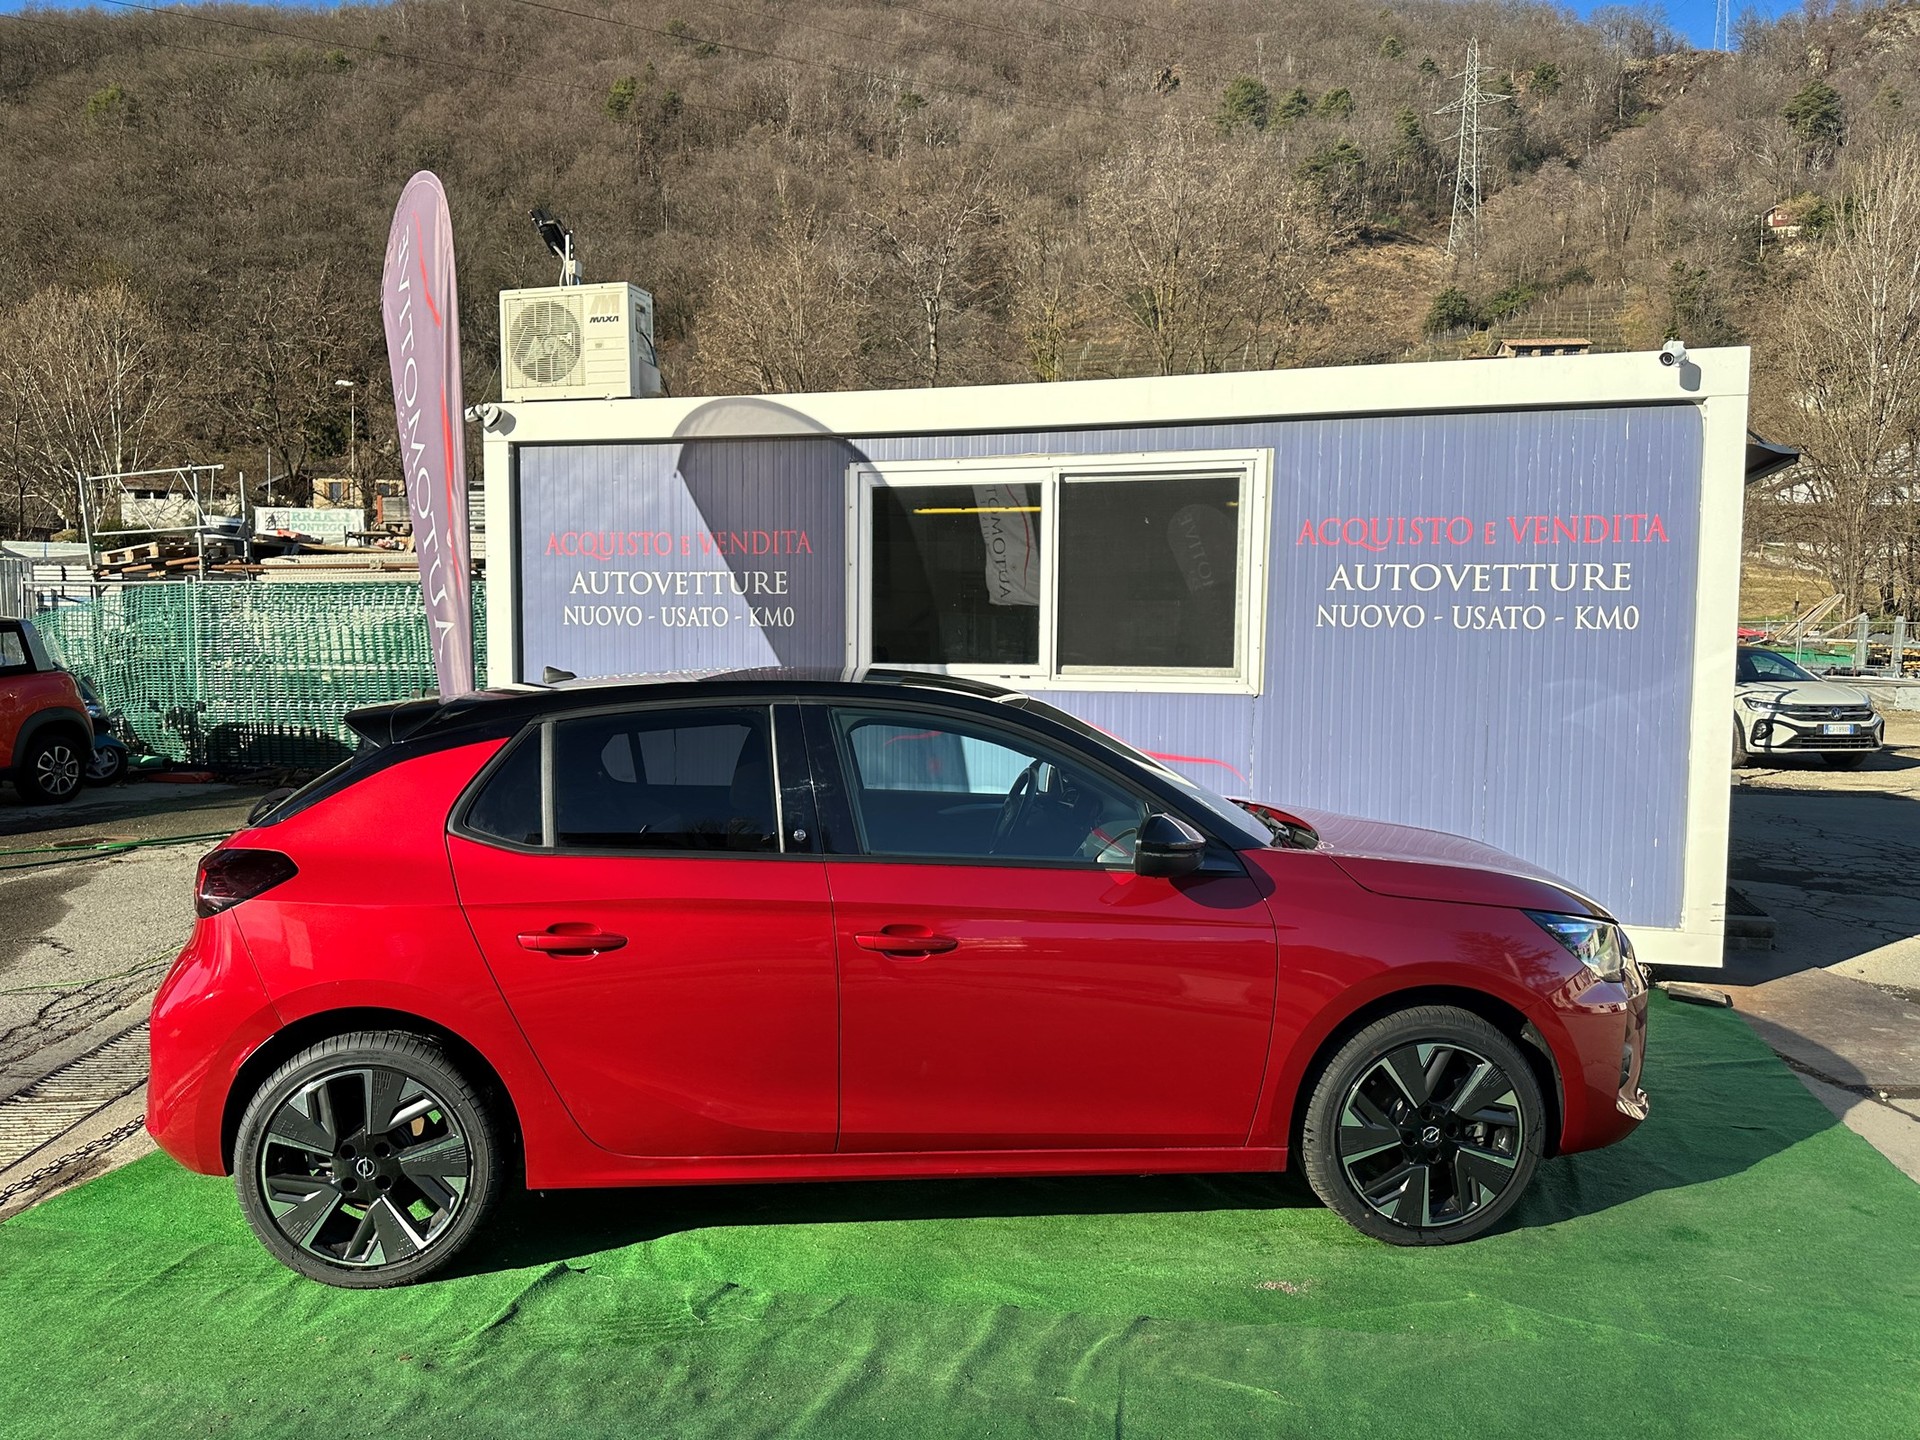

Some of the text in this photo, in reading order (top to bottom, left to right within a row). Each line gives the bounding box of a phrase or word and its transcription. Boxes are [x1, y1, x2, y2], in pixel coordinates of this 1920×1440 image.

[545, 531, 673, 560] ACQUISTO
[697, 530, 813, 555] VENDITA
[1296, 517, 1474, 551] ACQUISTO
[1507, 514, 1670, 543] VENDITA
[569, 571, 788, 596] AUTOVETTURE
[1326, 562, 1632, 592] AUTOVETTURE
[563, 605, 643, 627] NUOVO
[661, 606, 729, 628] USATO
[749, 606, 795, 628] KM0
[1316, 604, 1425, 629] NUOVO
[1452, 605, 1546, 631] USATO
[1575, 605, 1640, 630] KM0
